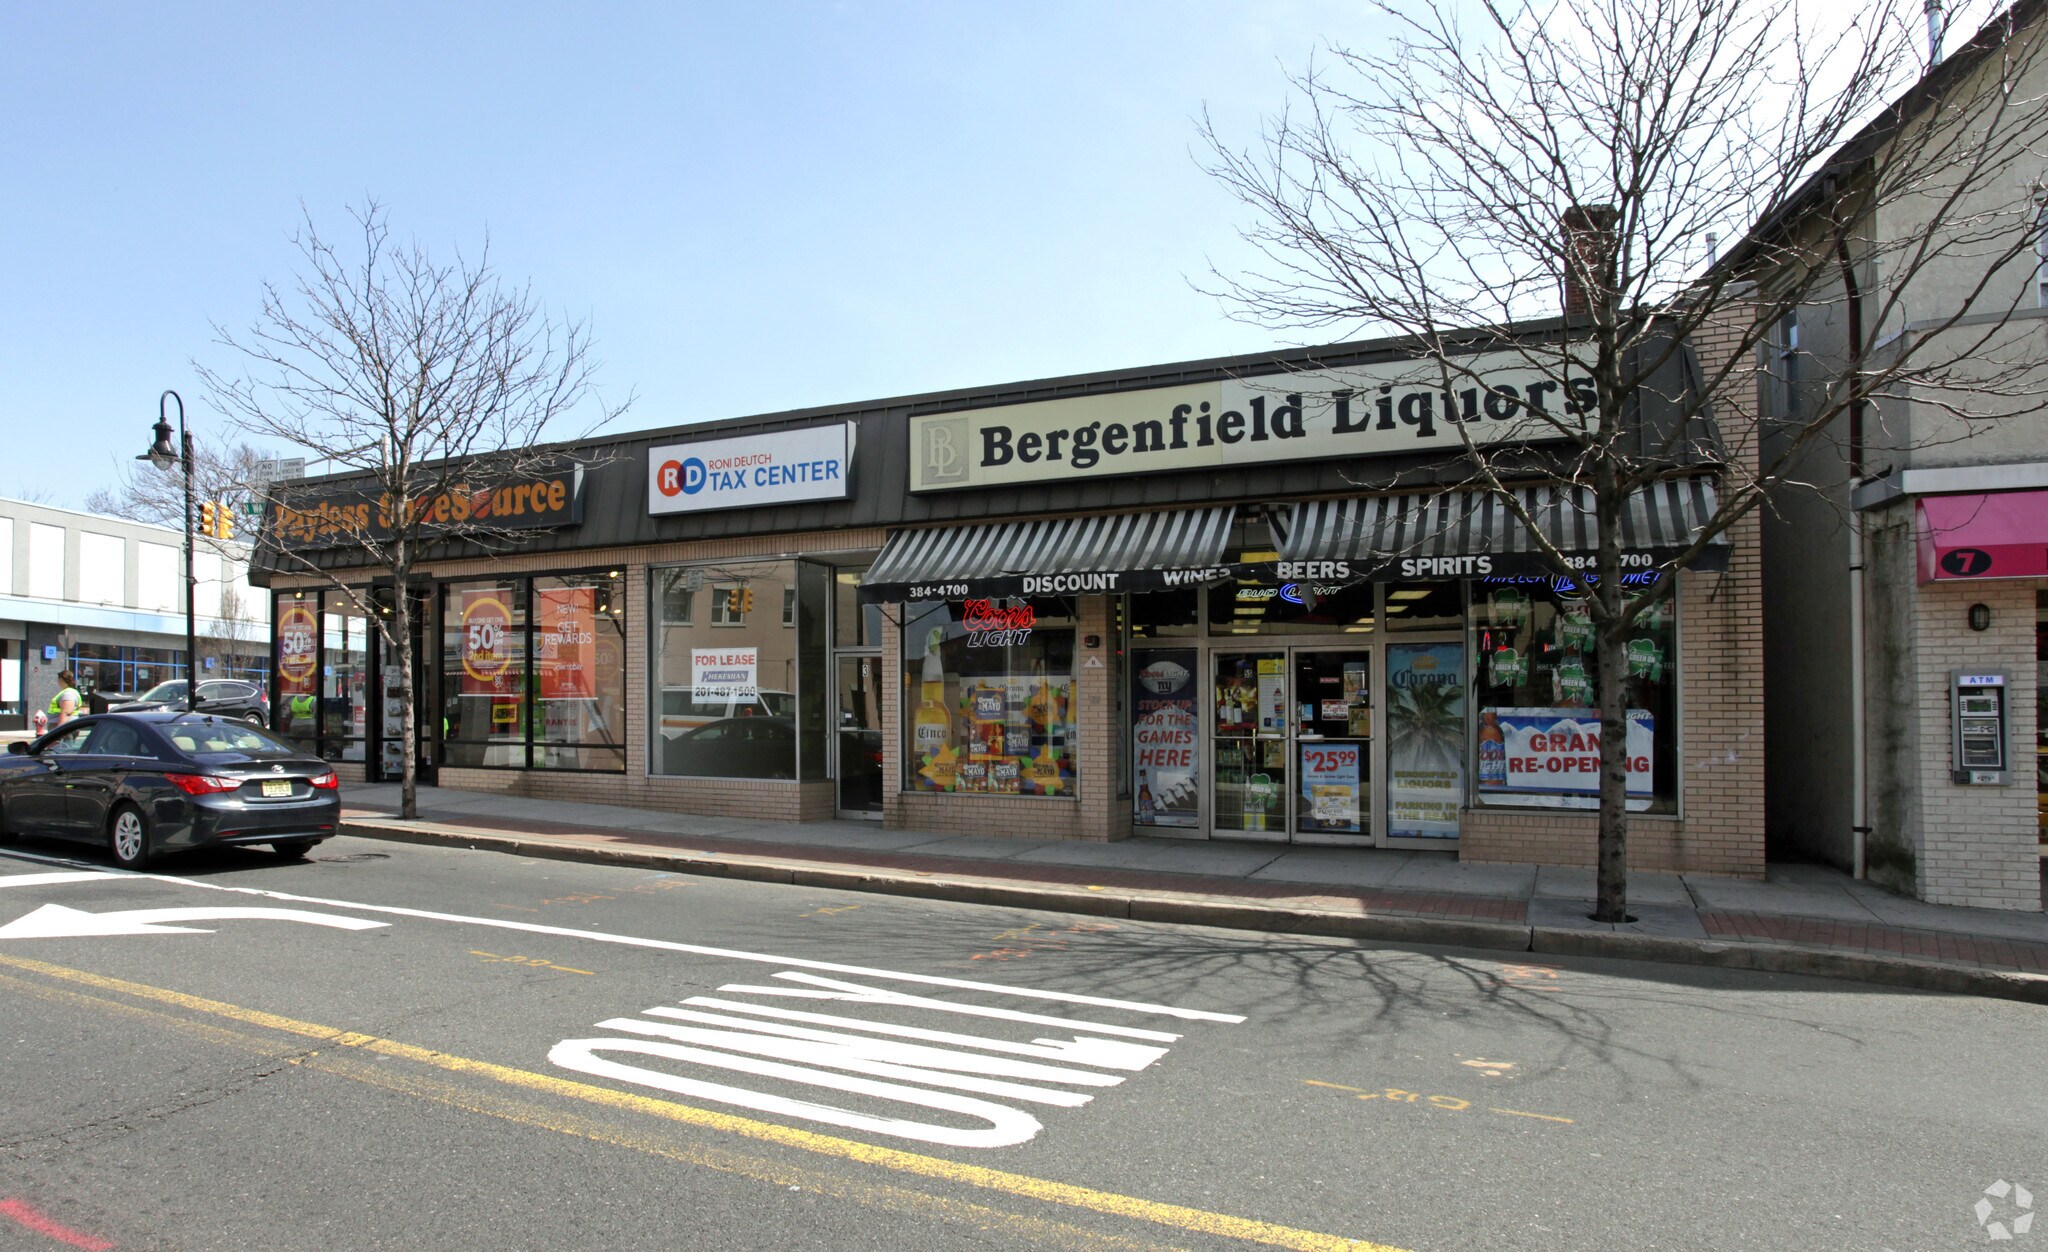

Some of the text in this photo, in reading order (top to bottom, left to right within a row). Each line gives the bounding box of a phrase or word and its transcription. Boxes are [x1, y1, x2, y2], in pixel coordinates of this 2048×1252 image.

[980, 376, 1599, 470] Bergenfield Liquors
[708, 453, 773, 471] RONI DEUTCH
[708, 458, 841, 492] TAX CENTER
[275, 501, 370, 543] Payless
[1956, 552, 1976, 573] 7
[1023, 555, 1492, 594] DISCOUNT WINES BEERS SPIRITS
[909, 584, 969, 598] 384-4700
[557, 604, 579, 614] NEW!
[963, 599, 1037, 631] Coors
[557, 621, 578, 634] GET
[544, 632, 593, 646] REWARDS
[967, 628, 1032, 648] LIGHT
[695, 654, 756, 666] FOR LEASE
[1495, 662, 1512, 671] GREEN
[1164, 669, 1190, 678] LIGHT
[1392, 664, 1458, 691] Corona
[1970, 676, 1994, 684] ATM
[1561, 679, 1578, 688] GREEN
[695, 686, 756, 697] 201-487-1500
[1138, 699, 1174, 711] STOCK
[1139, 713, 1192, 726] FOR THE
[917, 726, 947, 739] Cinco
[1138, 730, 1193, 744] GAMES
[1529, 733, 1602, 753] GRAN
[1139, 749, 1192, 767] HERE
[1394, 770, 1458, 779] BERGENFIELD
[1397, 779, 1452, 790] LIQUORS
[1395, 801, 1457, 811] PARKING IN
[547, 970, 1185, 1149] ONLY
